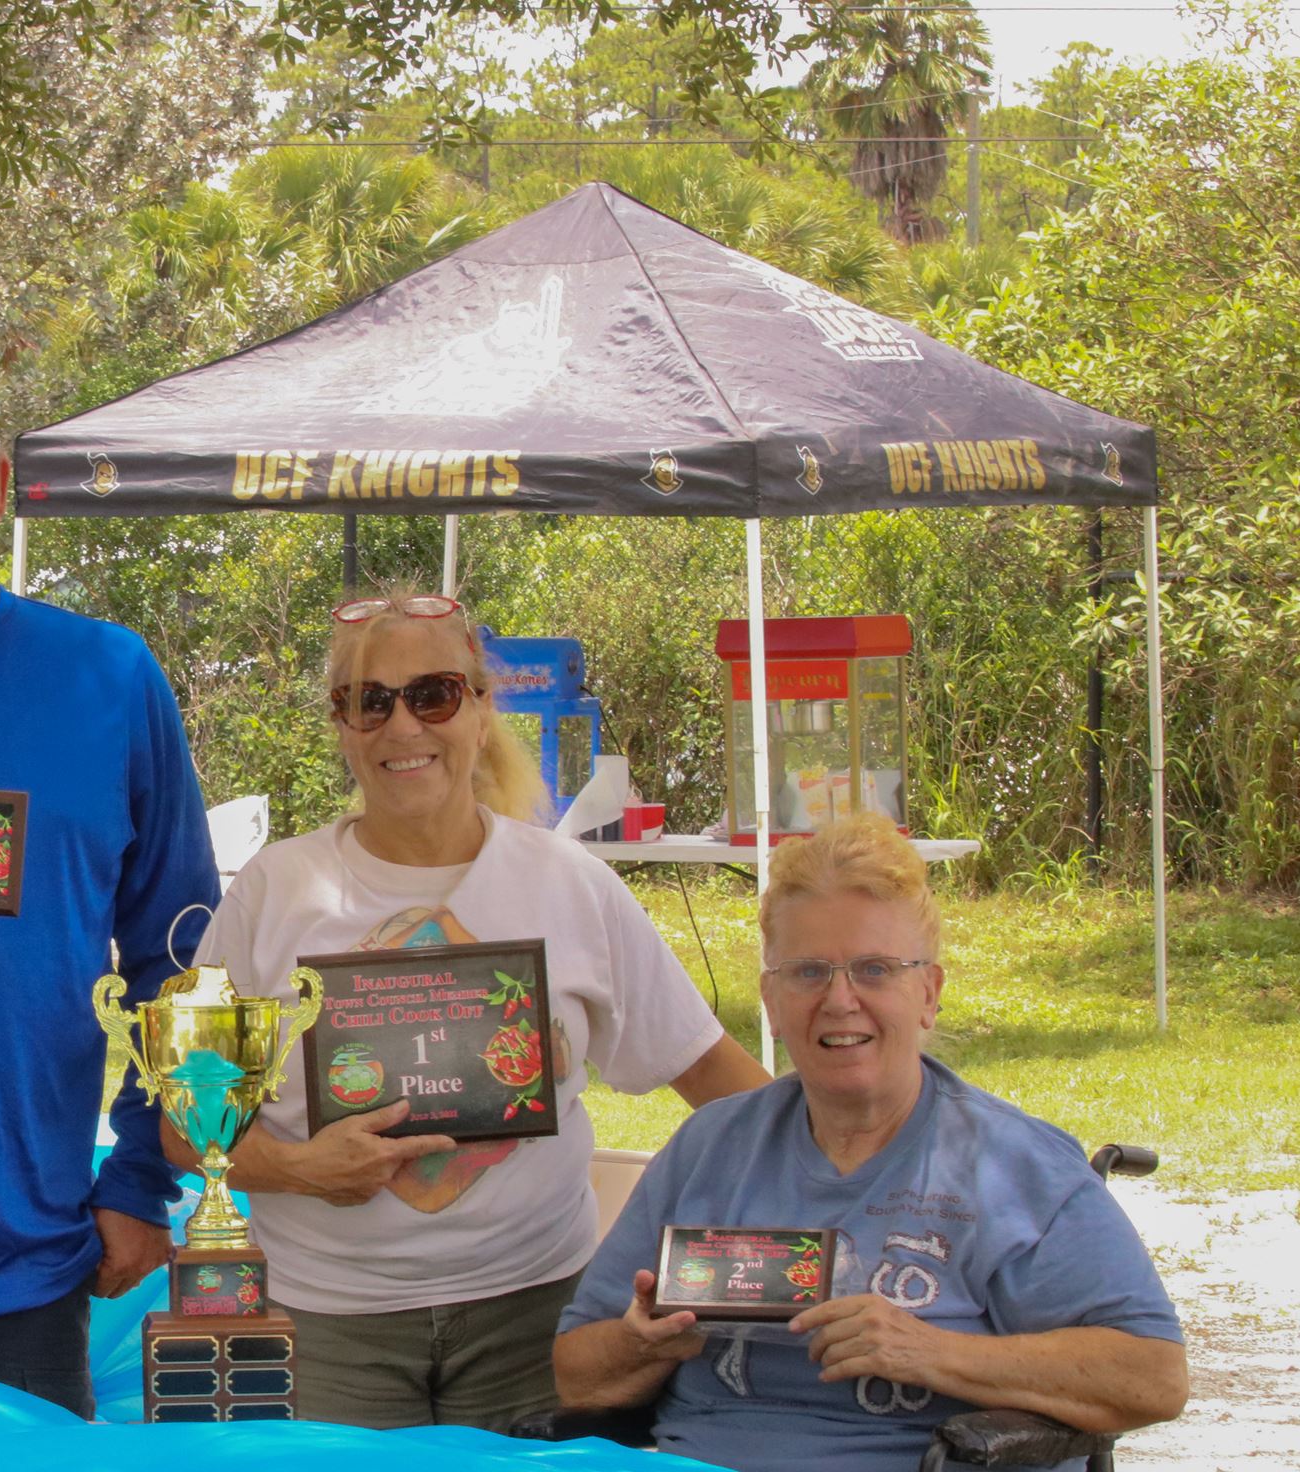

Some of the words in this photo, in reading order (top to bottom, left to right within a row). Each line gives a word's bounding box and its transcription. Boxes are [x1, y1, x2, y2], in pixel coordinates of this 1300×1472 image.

[810, 308, 902, 343] UCF
[846, 344, 911, 356] KNIGHTS
[232, 450, 321, 500] UCF
[328, 450, 522, 499] KNIGHTS
[880, 441, 933, 494] UCF
[933, 439, 1047, 492] KNIGHTS
[352, 972, 457, 992] INAUGURAL
[325, 997, 364, 1011] TOWN
[366, 992, 427, 1008] COUNCIL
[331, 1011, 384, 1029] CHILI
[388, 1006, 443, 1025] COOK
[446, 1002, 485, 1020] OFF
[411, 1027, 447, 1065] 1st
[401, 1075, 464, 1096] Place
[731, 1259, 763, 1279] 2nd
[726, 1279, 764, 1289] Place
